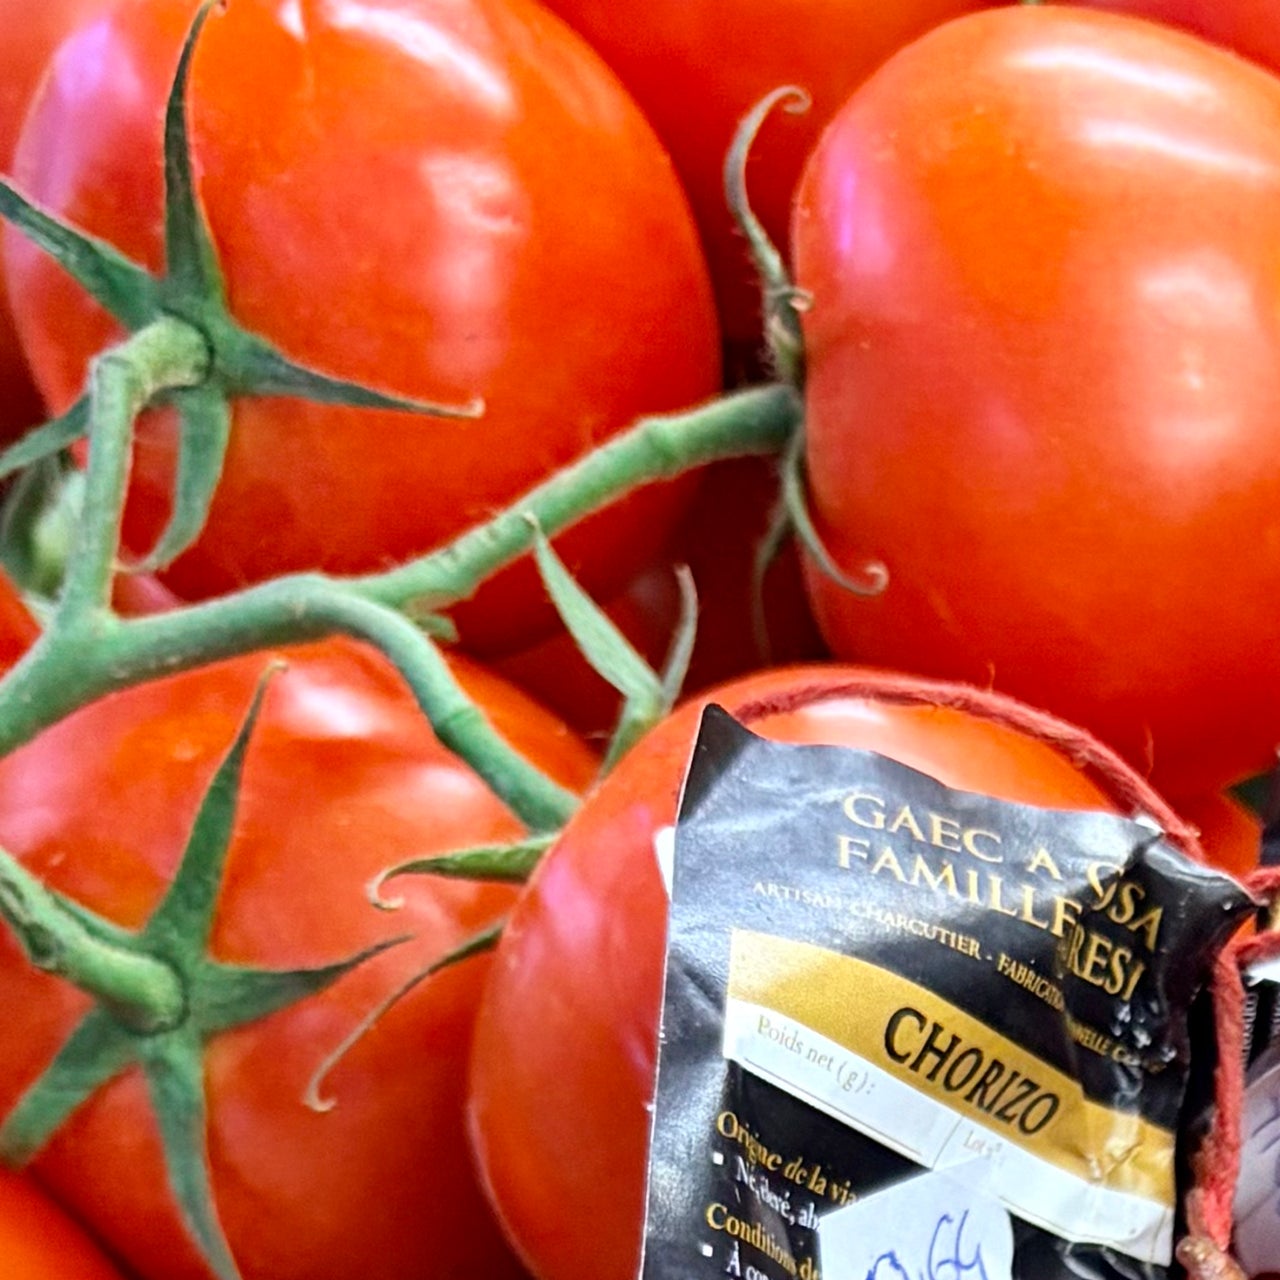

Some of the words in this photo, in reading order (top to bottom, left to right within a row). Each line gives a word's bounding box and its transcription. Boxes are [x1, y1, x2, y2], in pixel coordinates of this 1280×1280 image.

[843, 791, 1004, 864] GAEC
[1027, 846, 1064, 881] A
[853, 903, 982, 961] CHARCUTIER
[756, 1014, 804, 1055] Poids
[806, 1041, 834, 1072] net
[884, 1005, 1061, 1137] CHORIZO
[784, 1156, 808, 1186] de
[808, 1165, 827, 1196] la
[706, 1203, 798, 1276] Conditions
